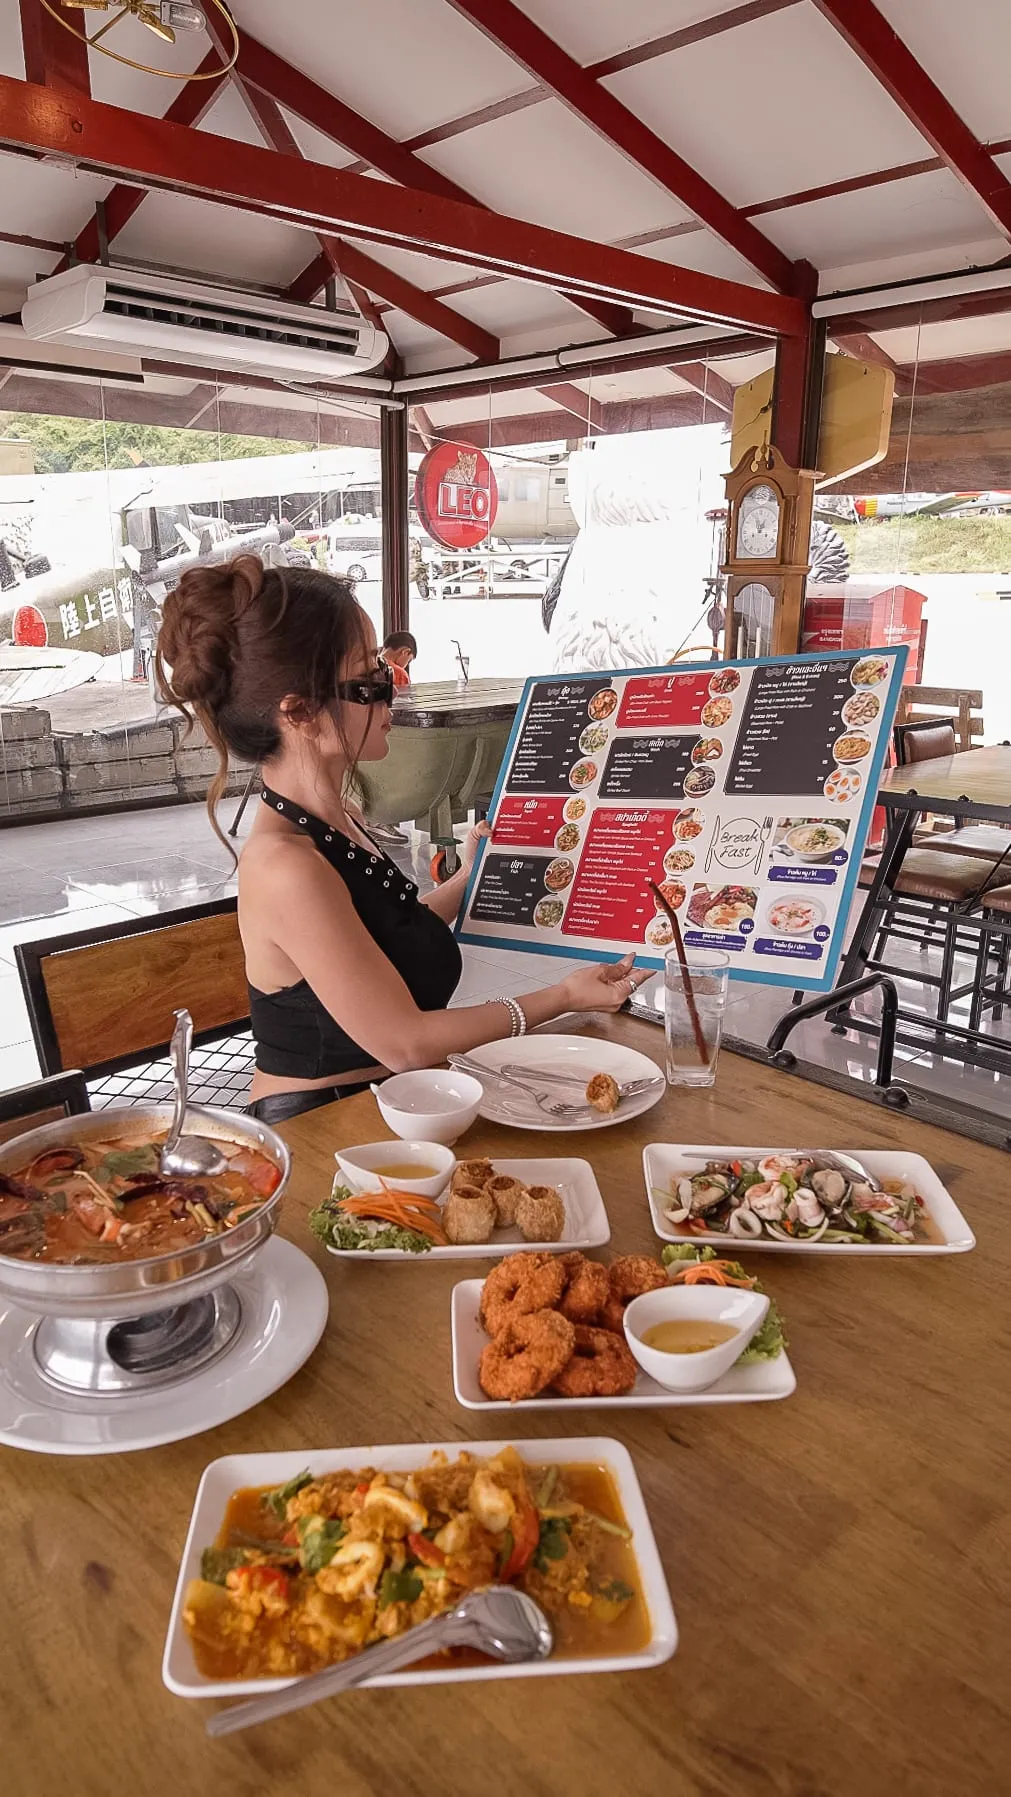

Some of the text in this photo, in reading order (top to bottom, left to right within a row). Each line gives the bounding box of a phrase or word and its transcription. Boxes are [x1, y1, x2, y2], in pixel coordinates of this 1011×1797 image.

[440, 483, 489, 520] LEO
[720, 829, 759, 843] Break
[719, 845, 752, 858] Fast
